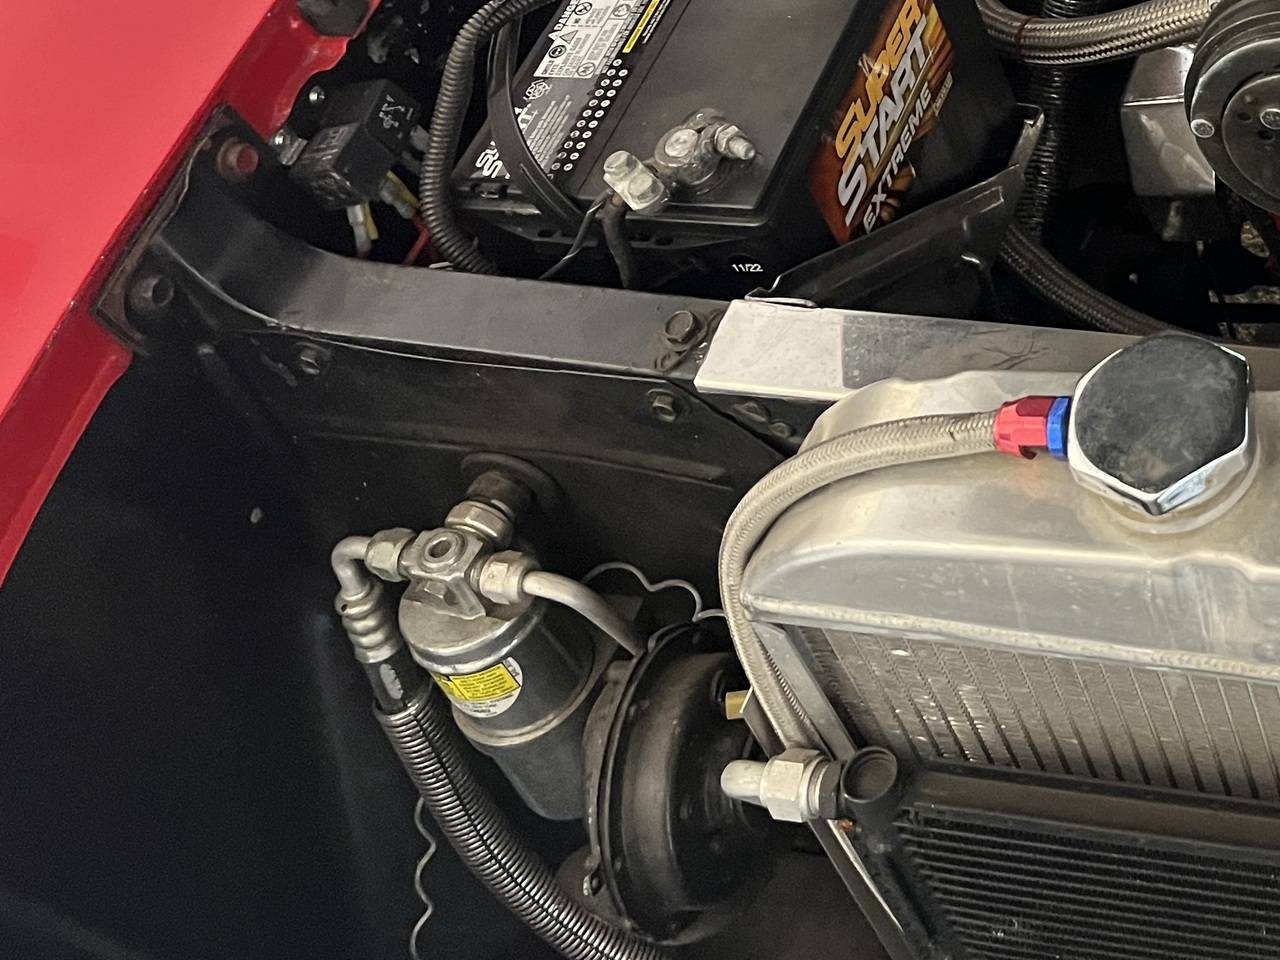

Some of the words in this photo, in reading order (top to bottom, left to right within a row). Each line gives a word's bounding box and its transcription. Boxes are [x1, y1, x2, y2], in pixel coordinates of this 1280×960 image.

[838, 13, 928, 227] START
[863, 80, 932, 233] EXTREME
[731, 263, 764, 272] 11/22
